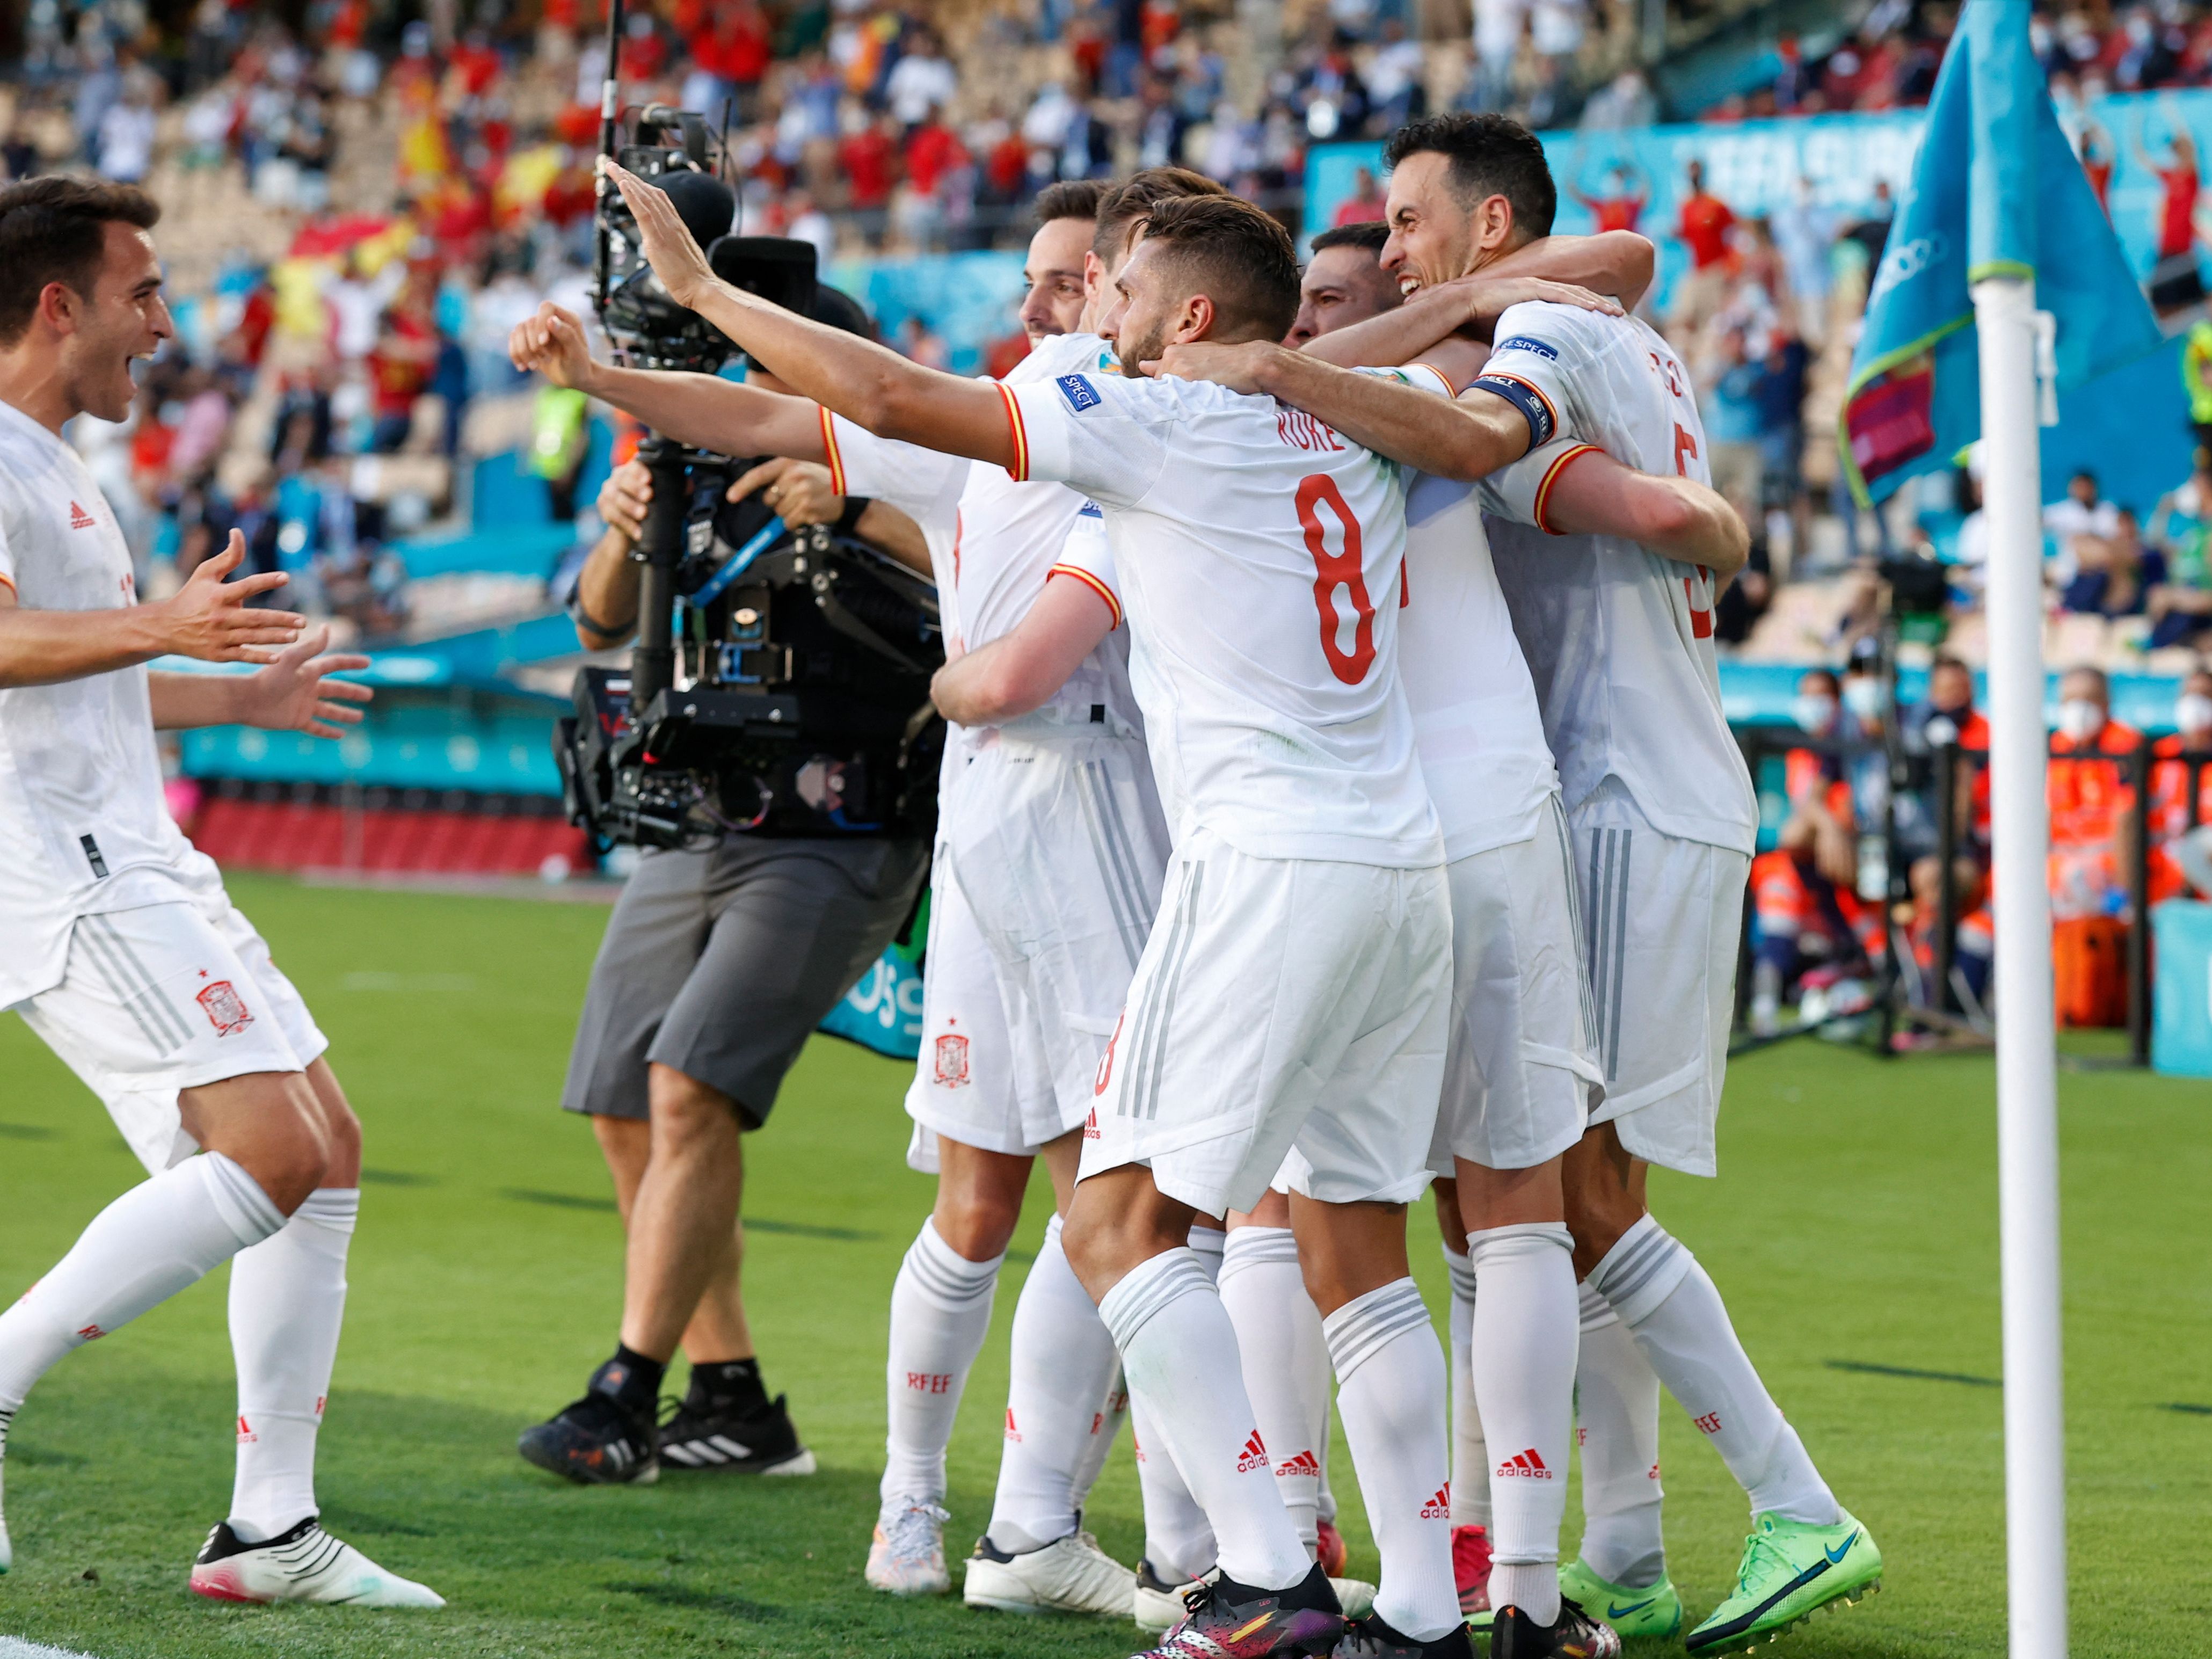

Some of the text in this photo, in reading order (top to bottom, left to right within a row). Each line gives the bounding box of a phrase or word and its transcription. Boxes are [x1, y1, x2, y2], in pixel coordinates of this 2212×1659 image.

[1065, 376, 1094, 406] SPECT
[1274, 412, 1347, 452] KOKE
[1294, 474, 1377, 685] 8
[907, 1372, 954, 1394] RFEF
[1237, 1456, 1269, 1473] adid
[1497, 1467, 1552, 1479] adidas
